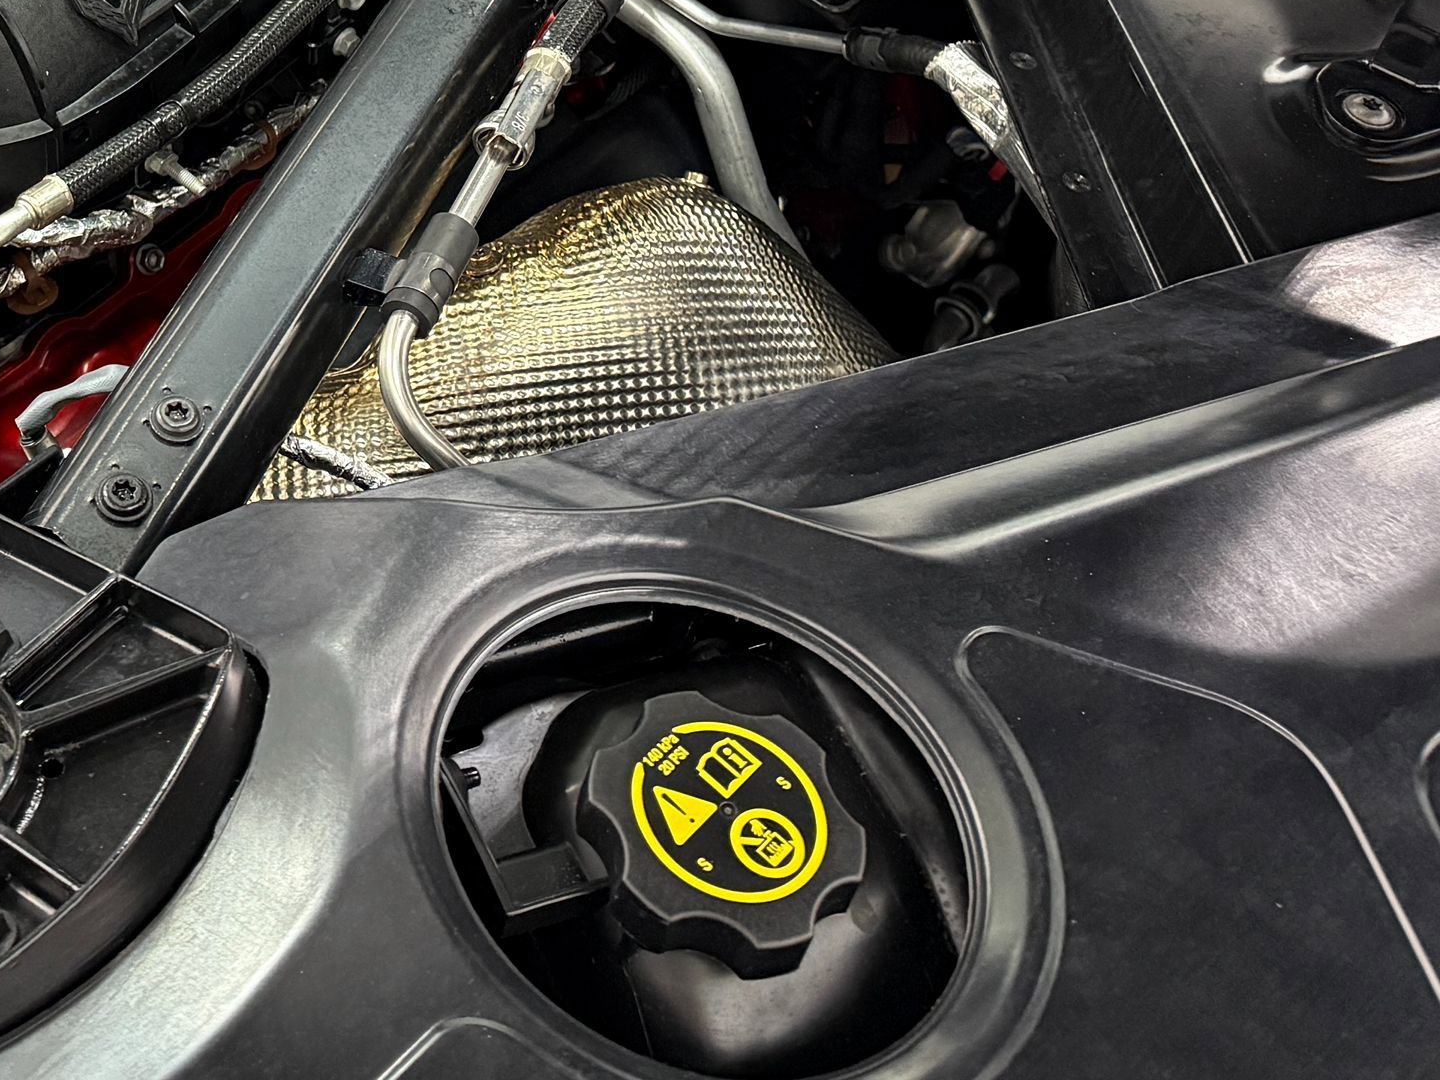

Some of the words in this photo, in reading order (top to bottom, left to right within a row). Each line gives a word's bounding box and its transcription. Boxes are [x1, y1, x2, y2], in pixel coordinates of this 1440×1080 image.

[511, 111, 530, 132] 3/8
[642, 747, 664, 767] 140
[656, 734, 680, 753] kPa
[658, 759, 675, 776] 20
[668, 745, 690, 765] PSI
